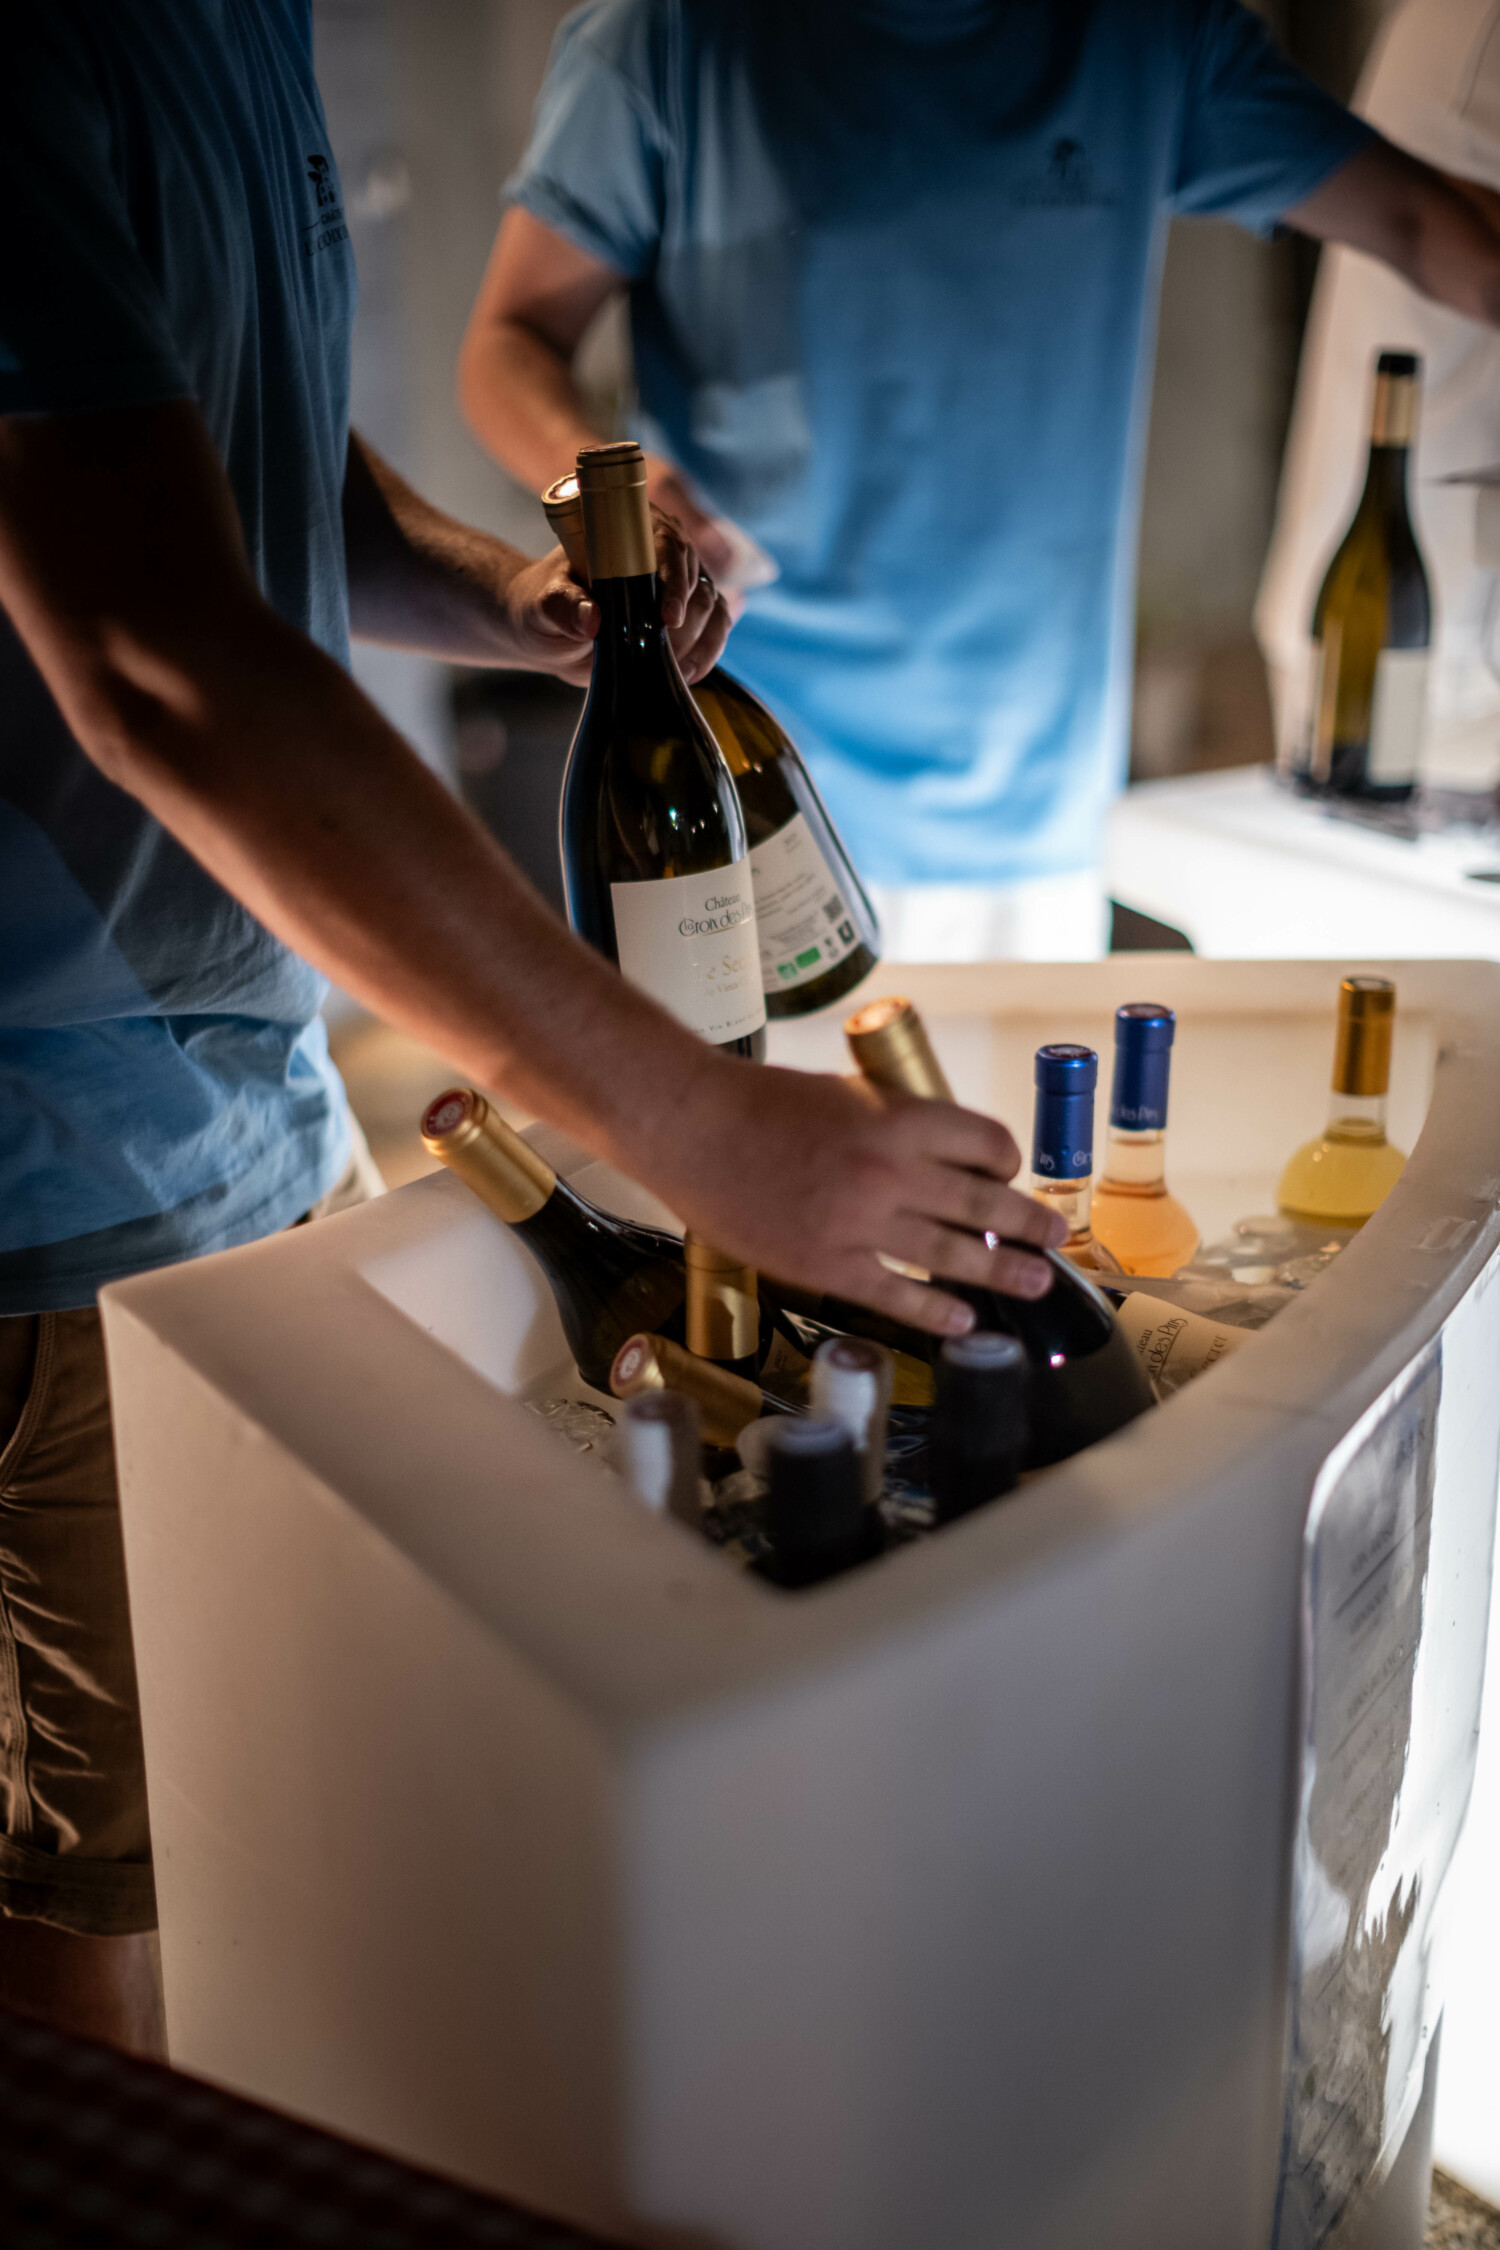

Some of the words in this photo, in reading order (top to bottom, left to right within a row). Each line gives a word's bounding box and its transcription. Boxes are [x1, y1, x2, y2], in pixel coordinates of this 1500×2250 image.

[1157, 1317, 1189, 1337] Pins
[1137, 1328, 1153, 1353] teau
[1147, 1336, 1171, 1363] des
